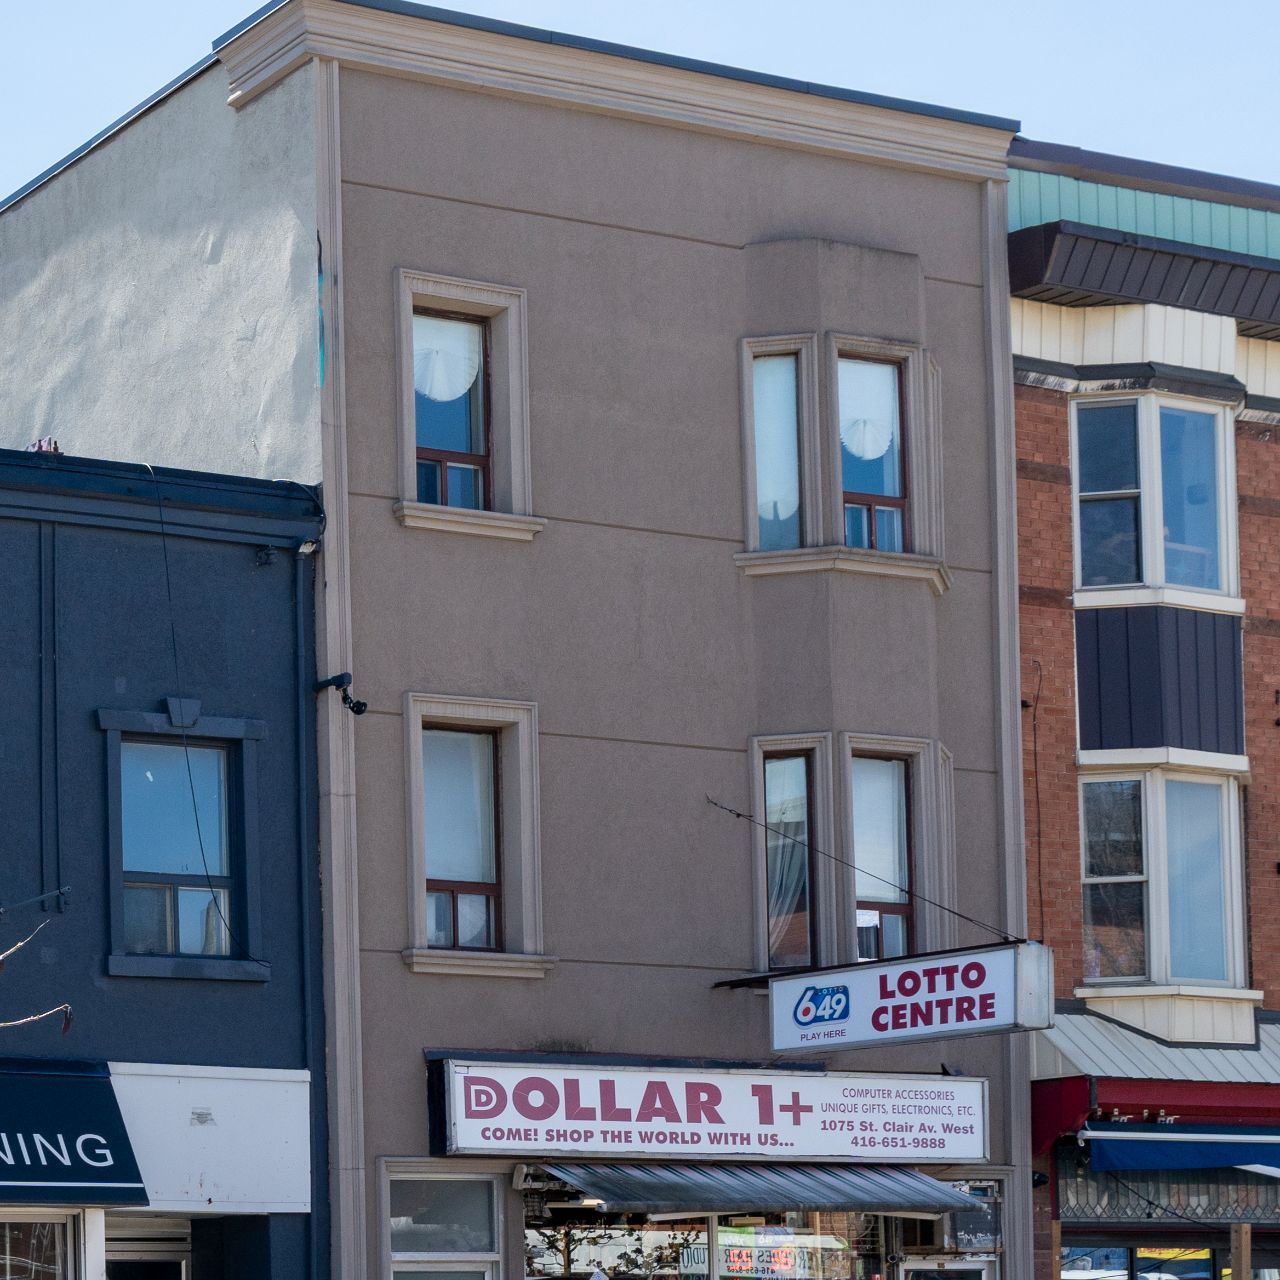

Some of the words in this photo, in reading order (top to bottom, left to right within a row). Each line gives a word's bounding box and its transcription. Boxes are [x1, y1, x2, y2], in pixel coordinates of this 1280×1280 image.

[880, 962, 987, 1000] LOTTO
[871, 993, 996, 1032] CENTRE
[800, 1031, 822, 1042] PLAY
[823, 1029, 847, 1040] HERE
[464, 1076, 726, 1125] DOLLAR
[751, 1084, 814, 1126] 1+
[842, 1087, 893, 1099] COMPUTER
[895, 1089, 955, 1101] ACCESSORIES
[820, 1103, 859, 1114] UNIQUE
[861, 1104, 889, 1115] GIFTS,
[892, 1104, 954, 1117] ELECTRONICS,
[957, 1105, 976, 1116] ETC.
[820, 1120, 855, 1131] 1075
[859, 1120, 879, 1132] St.
[883, 1121, 914, 1133] Clair
[918, 1122, 937, 1134] Av.
[941, 1123, 975, 1135] West
[481, 1126, 539, 1142] COME!
[545, 1128, 594, 1144] SHOP
[600, 1129, 633, 1144] THE
[638, 1130, 702, 1145] WORLD
[707, 1131, 752, 1146] WITH
[757, 1133, 795, 1147] US...
[850, 1136, 946, 1149] 416-651-9888
